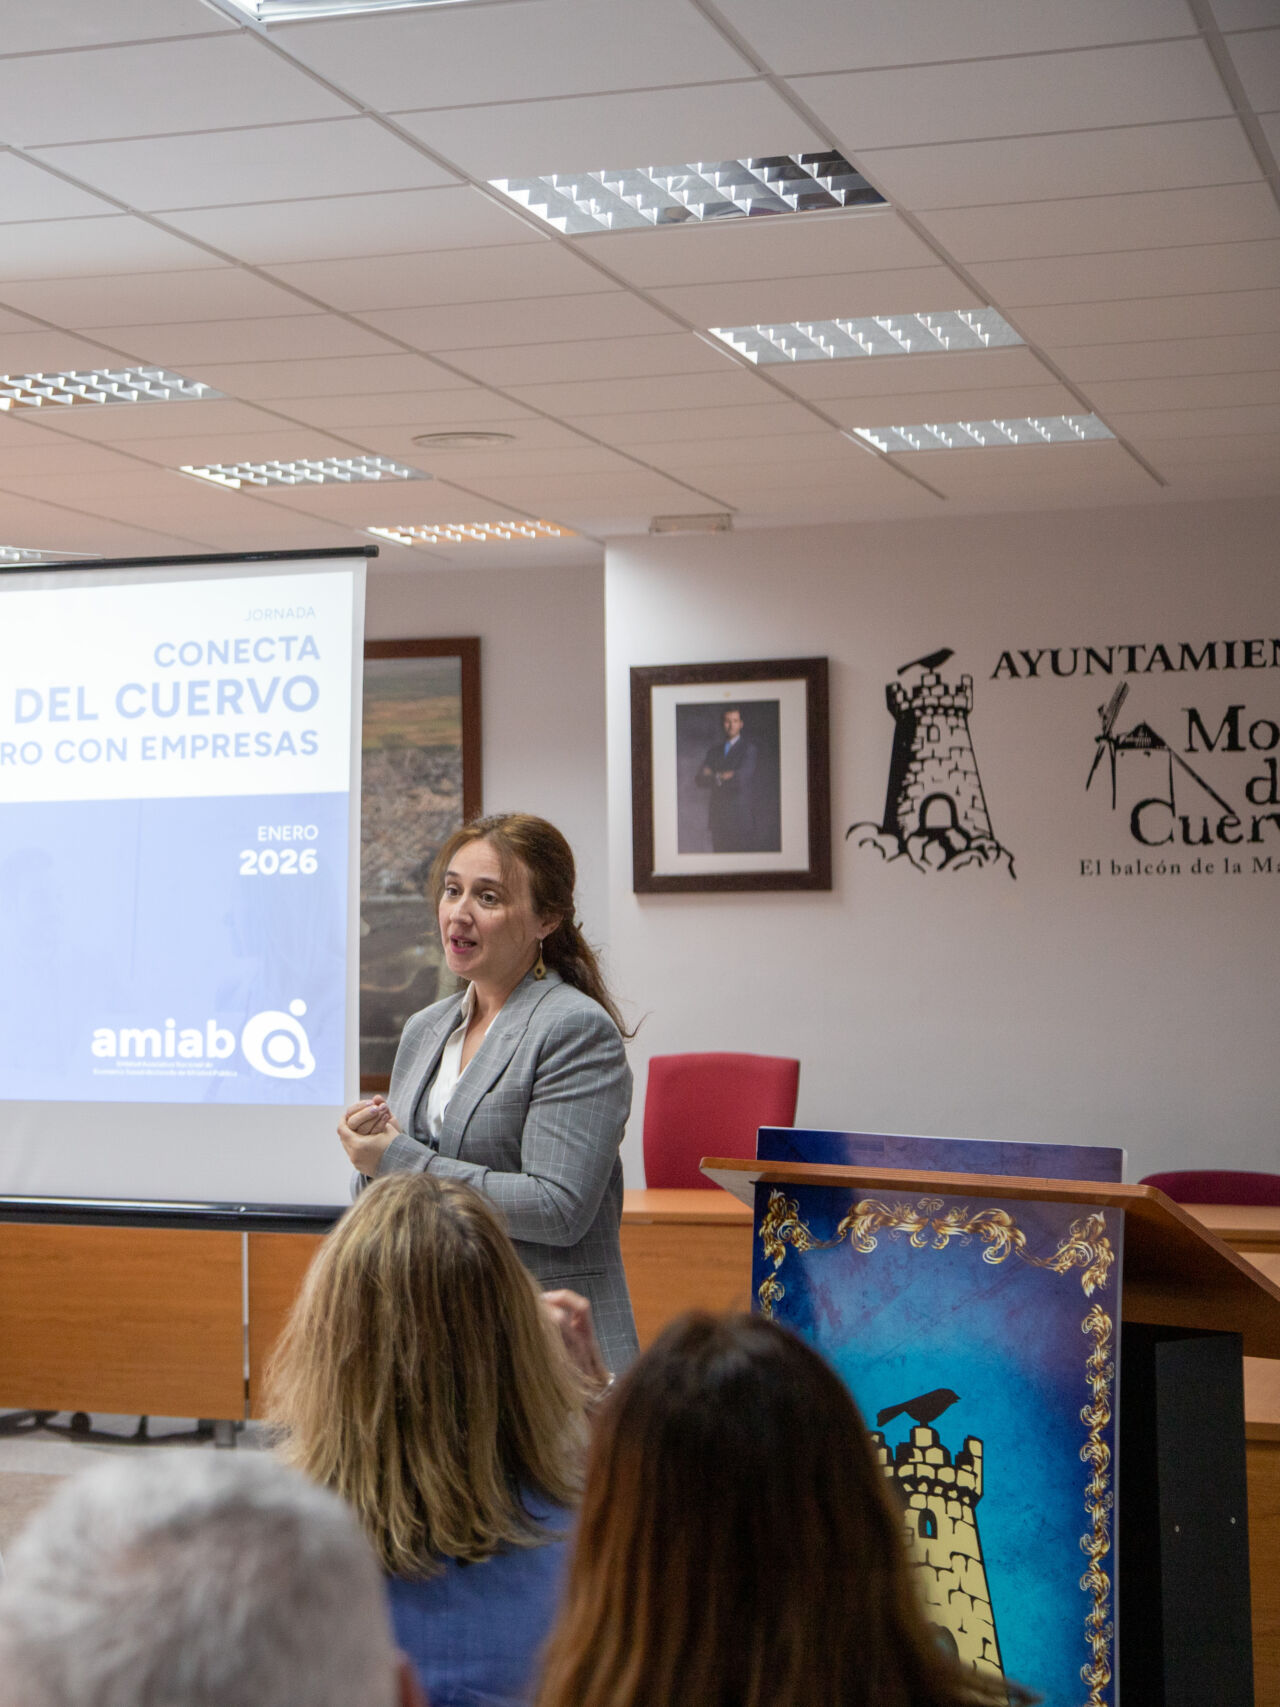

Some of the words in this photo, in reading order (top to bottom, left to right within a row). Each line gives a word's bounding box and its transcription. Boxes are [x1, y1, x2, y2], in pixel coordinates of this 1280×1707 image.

[243, 606, 317, 622] JORNADA
[153, 635, 321, 668] CONECTA
[990, 638, 1280, 680] AYUNTAMIE
[13, 686, 100, 725] DEL
[115, 674, 320, 719] CUERVO
[53, 737, 128, 763] CON
[140, 729, 320, 761] EMPRESAS
[257, 824, 320, 842] ENERO
[239, 848, 319, 875] 2026
[1080, 859, 1102, 876] El
[1111, 859, 1182, 876] balcón
[1191, 857, 1216, 875] de
[1224, 857, 1242, 875] la
[1252, 856, 1280, 874] M
[91, 1017, 237, 1059] amiab
